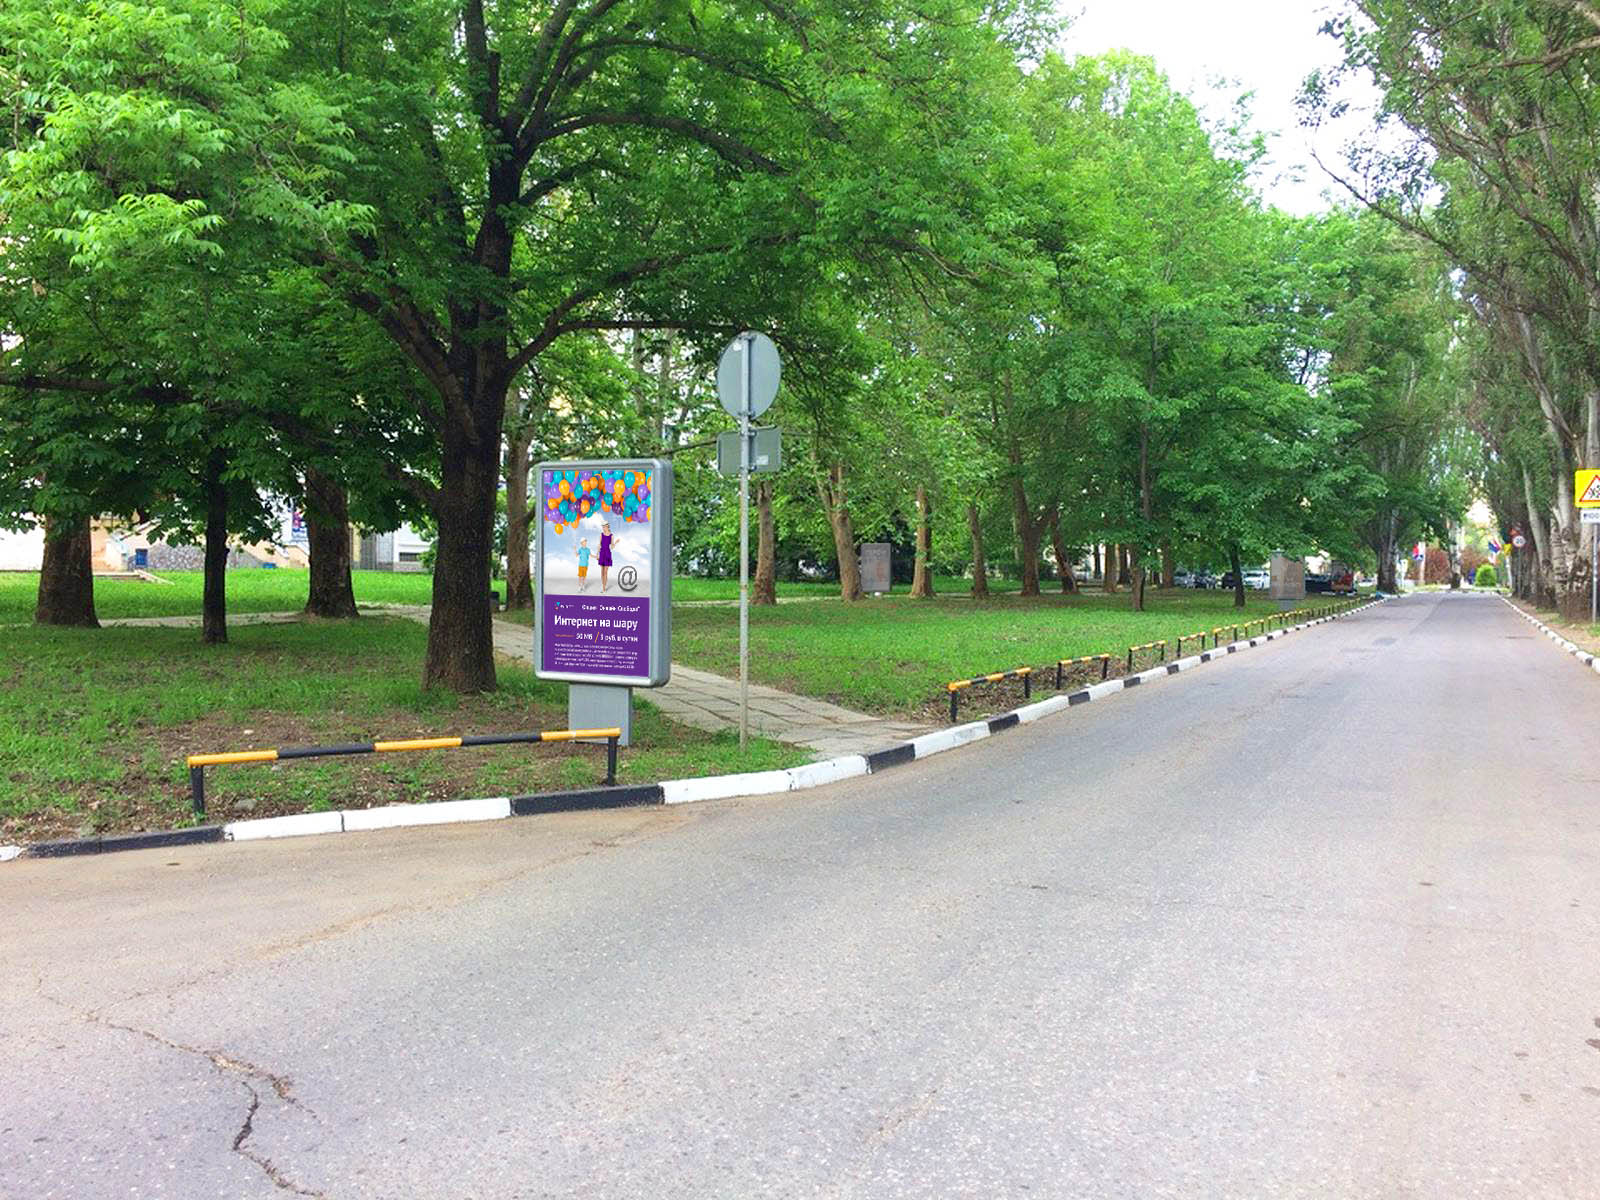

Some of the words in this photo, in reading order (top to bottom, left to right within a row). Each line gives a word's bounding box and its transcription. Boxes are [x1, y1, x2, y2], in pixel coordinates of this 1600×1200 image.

[554, 615, 598, 628] Интернет
[599, 618, 611, 628] на
[613, 620, 638, 631] шару
